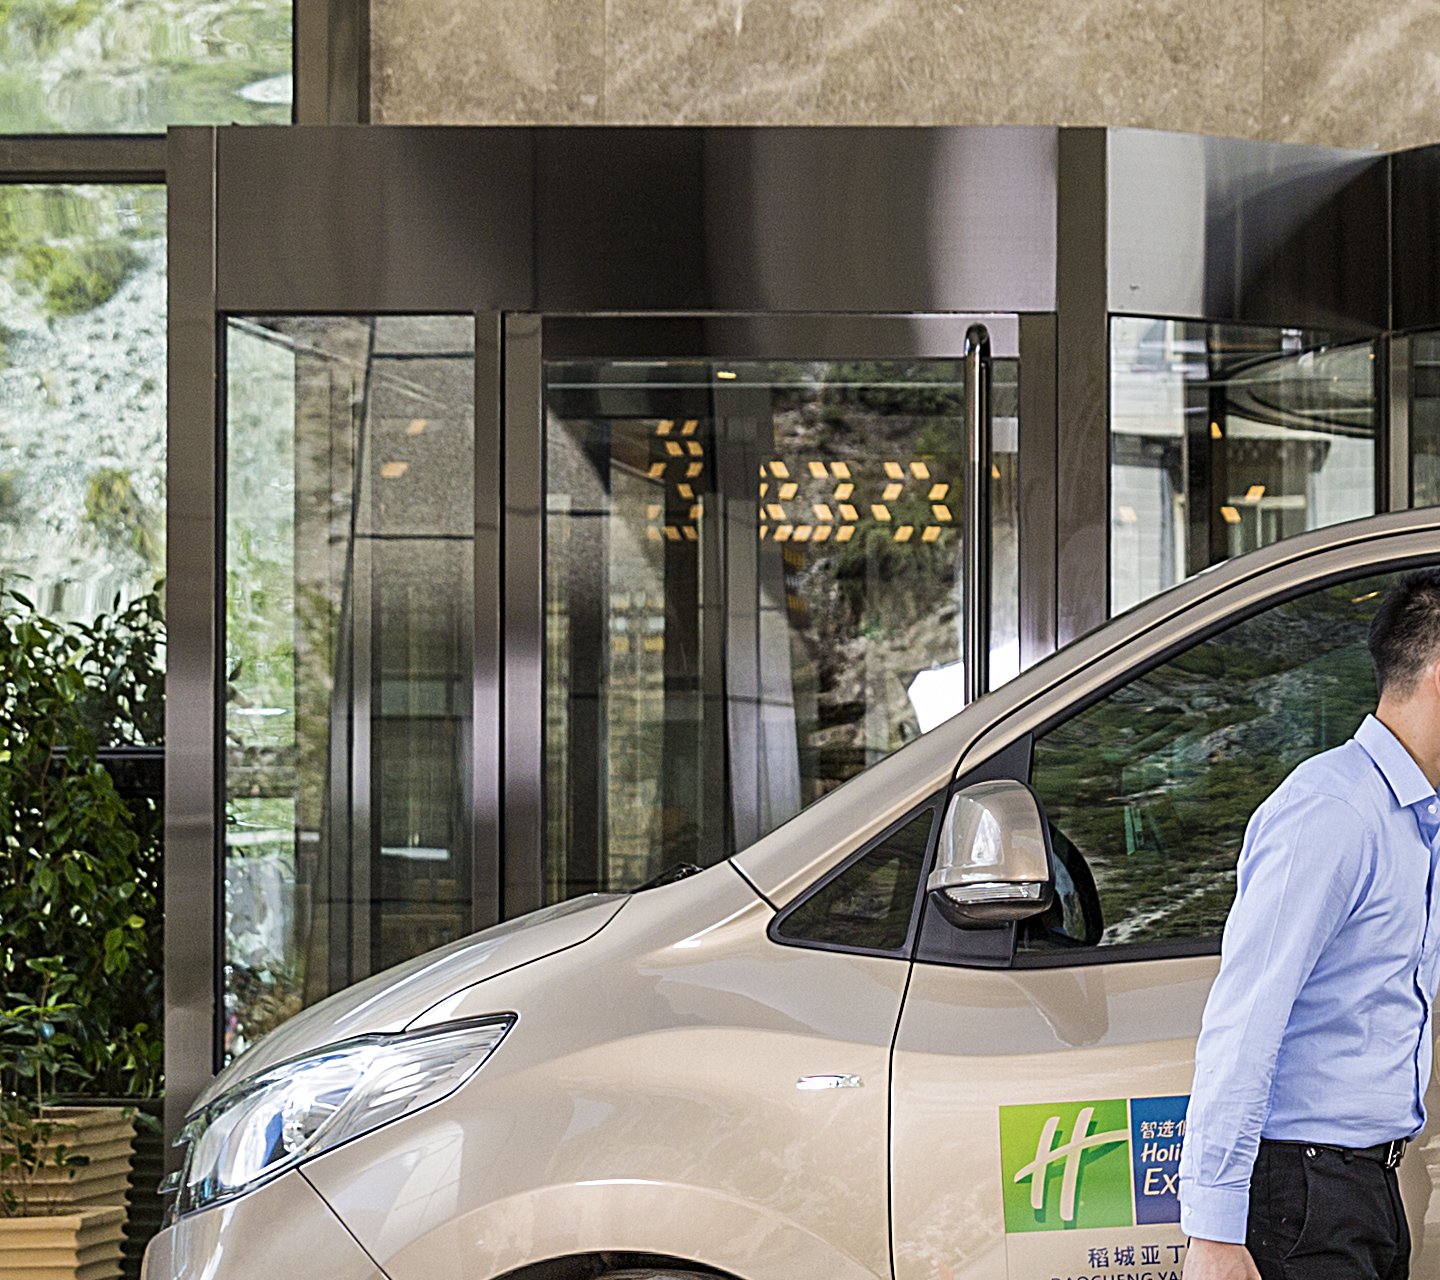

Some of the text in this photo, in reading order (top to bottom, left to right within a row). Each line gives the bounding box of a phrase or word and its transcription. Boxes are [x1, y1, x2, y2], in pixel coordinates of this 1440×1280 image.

[1141, 1142, 1181, 1163] Holi
[1143, 1167, 1180, 1201] Ex
[1088, 1245, 1185, 1268] 稻城亚丁
